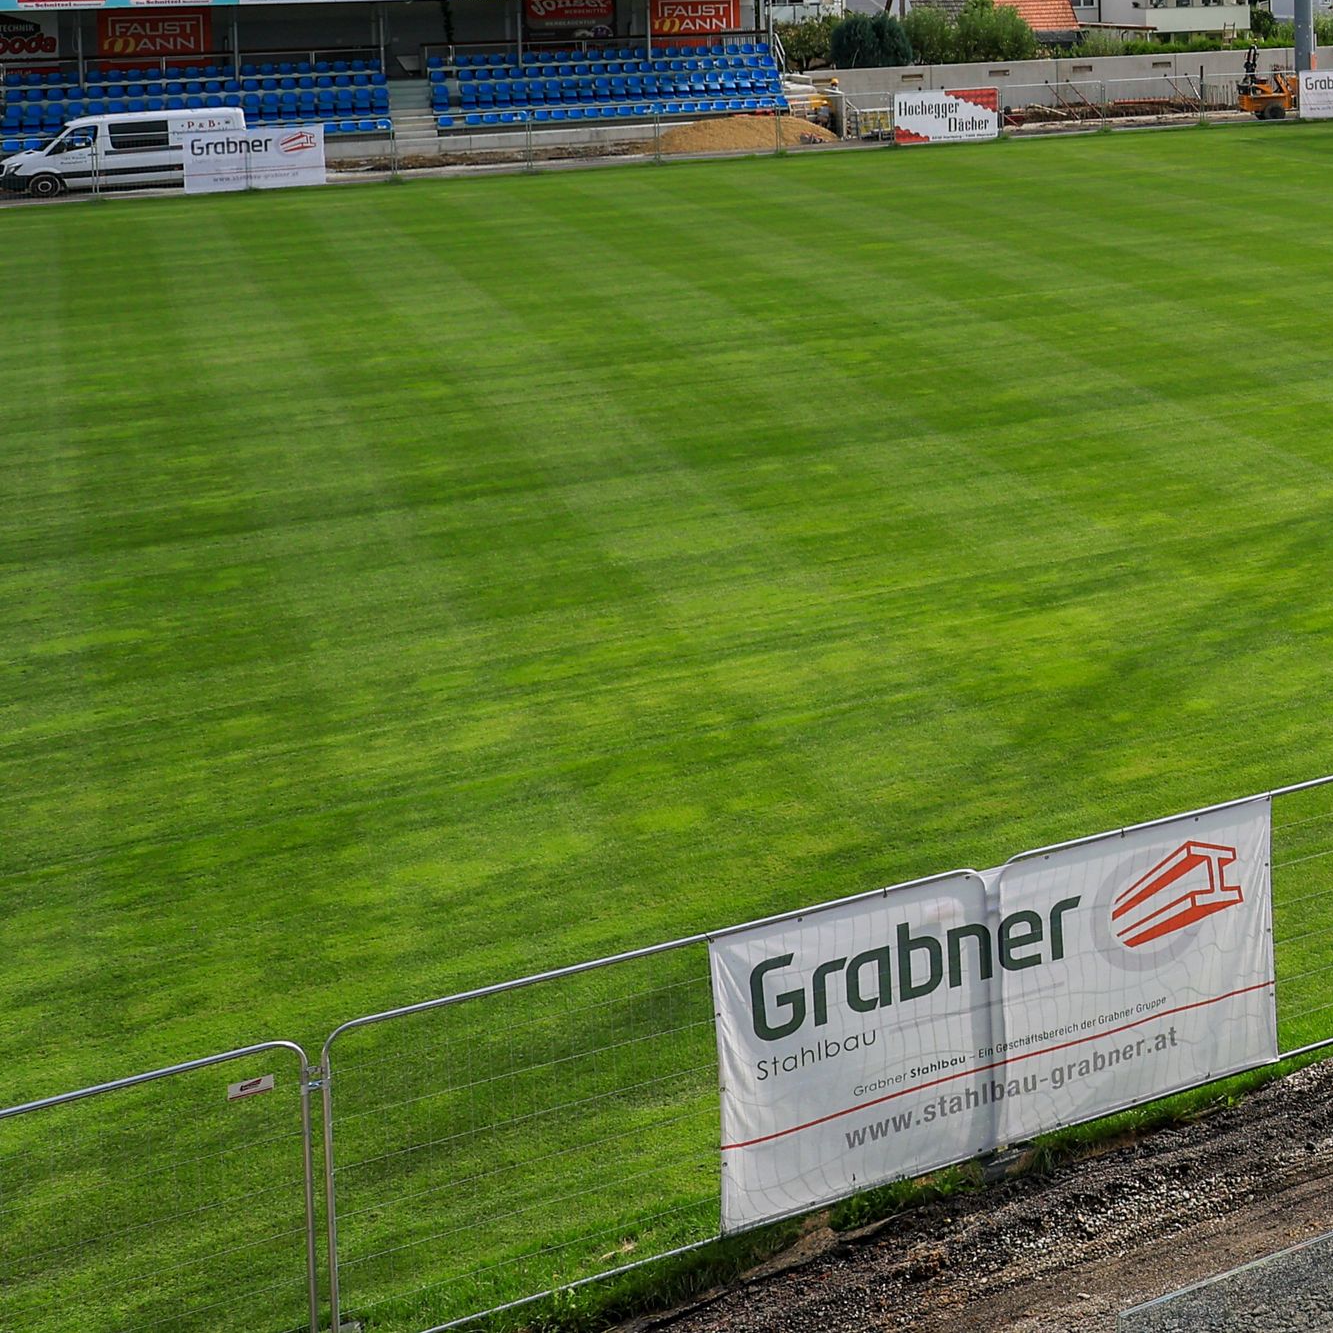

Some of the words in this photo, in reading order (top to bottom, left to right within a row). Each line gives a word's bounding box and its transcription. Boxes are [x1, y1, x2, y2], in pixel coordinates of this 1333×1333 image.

[664, 4, 728, 17] FAUST
[115, 21, 197, 36] FAUST
[898, 101, 959, 119] Hochegger
[187, 121, 194, 129] P
[208, 120, 215, 128] B
[948, 116, 989, 132] Dächer
[191, 138, 272, 156] Grabner
[750, 895, 1081, 1041] Grabner
[757, 1030, 876, 1080] Stahlbau
[854, 1071, 908, 1097] Grabner
[910, 1055, 966, 1078] Stahlbau
[978, 1046, 994, 1058] Ein
[996, 1023, 1079, 1053] Geschäftsbereich
[1080, 1018, 1096, 1030] der
[1098, 1007, 1134, 1025] Grabner
[1136, 996, 1167, 1014] Gruppe
[845, 1025, 1178, 1149] www.stahlbau-grabner.at
